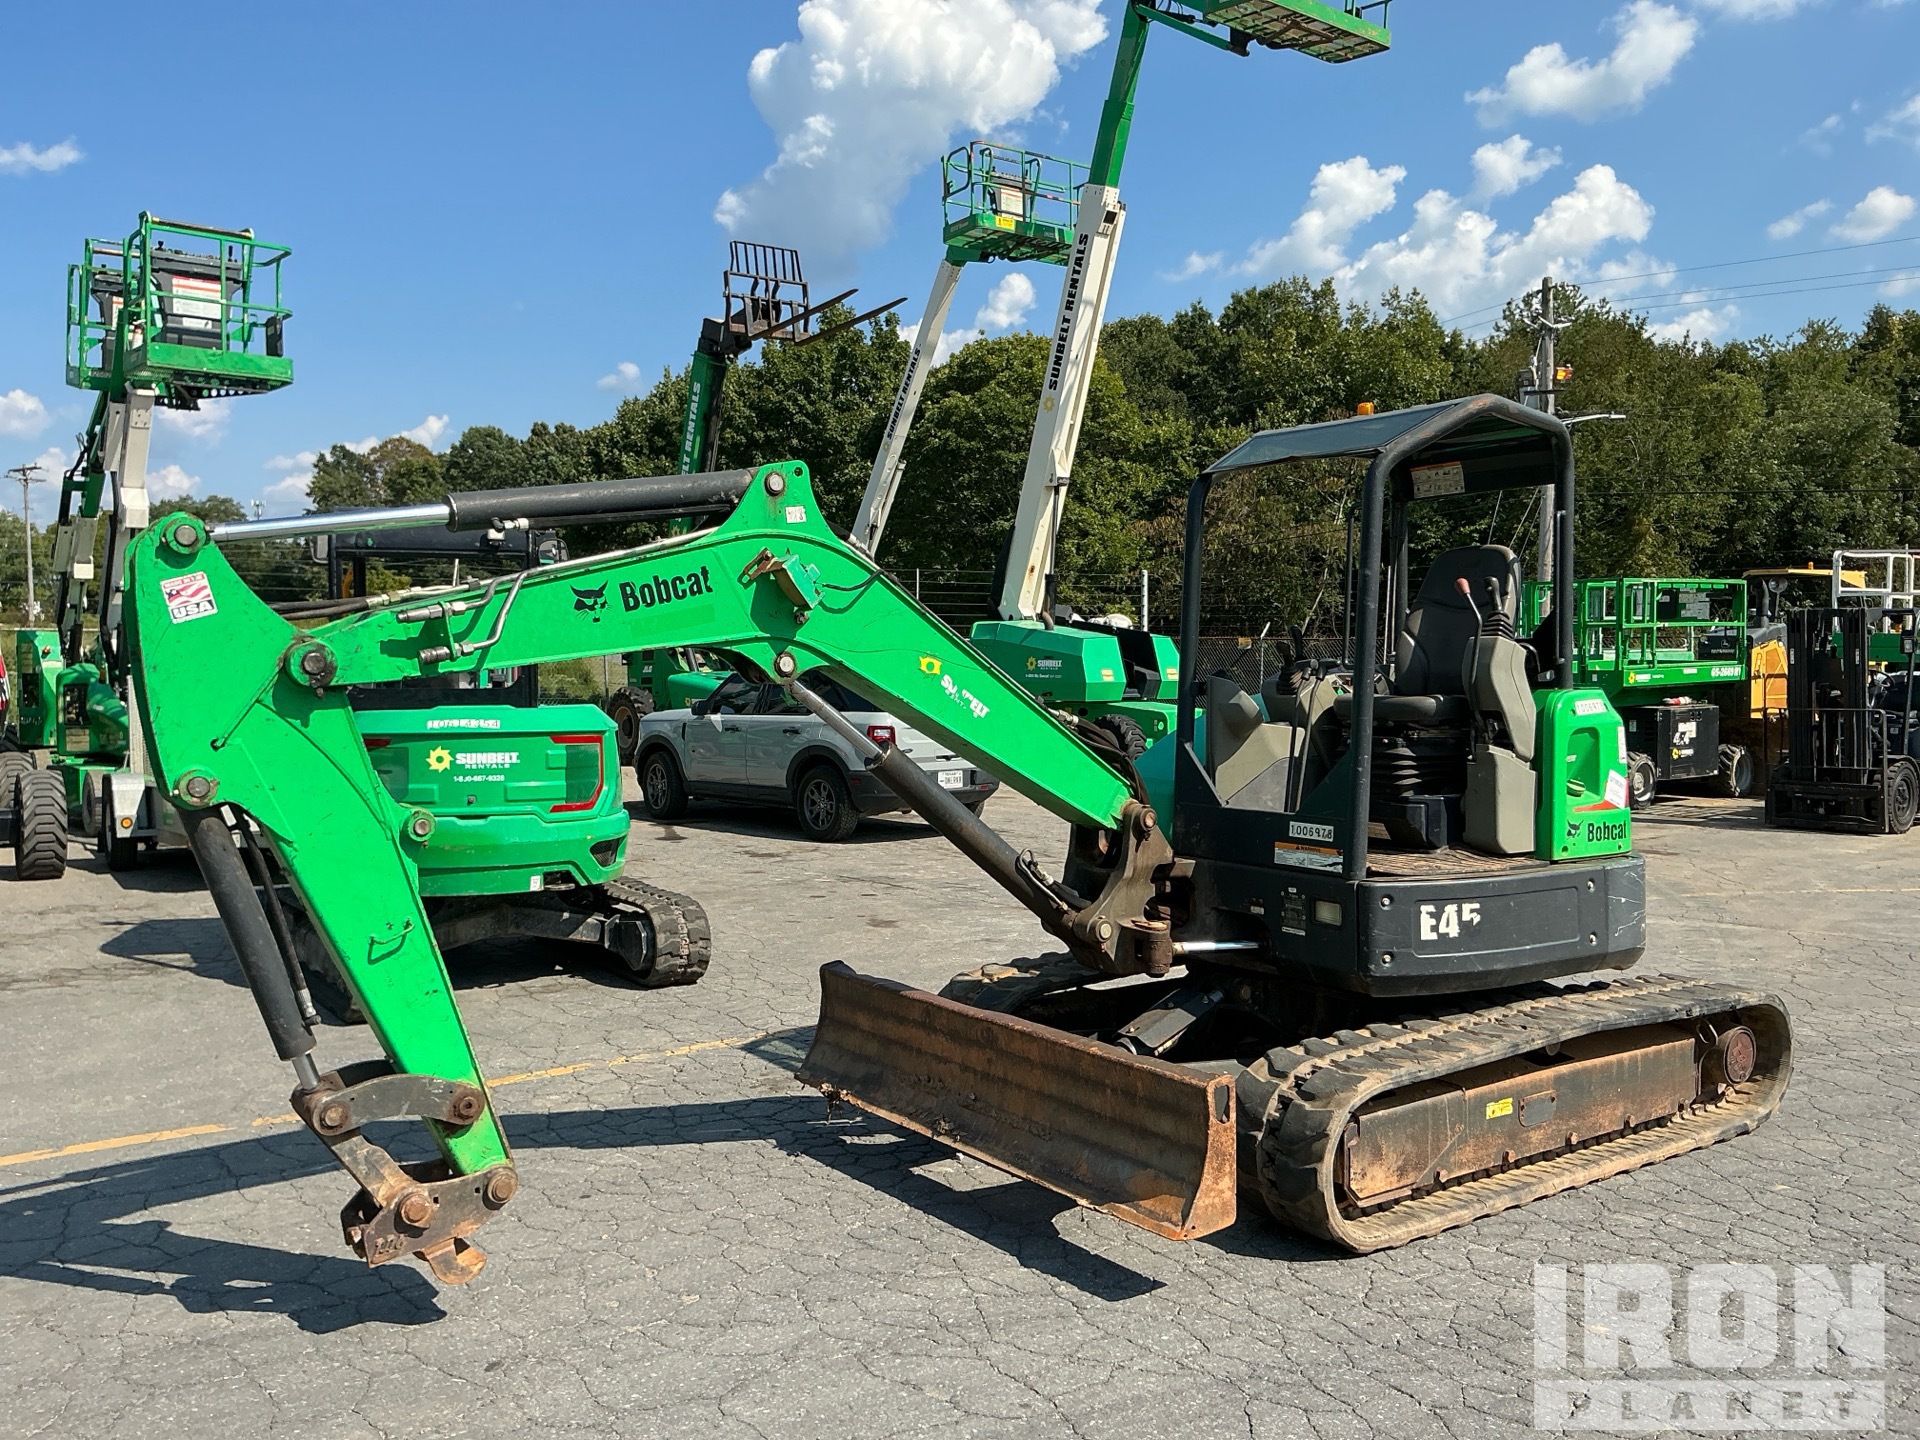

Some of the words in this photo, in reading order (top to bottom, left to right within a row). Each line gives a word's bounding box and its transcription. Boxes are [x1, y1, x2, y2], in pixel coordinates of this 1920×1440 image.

[1048, 315, 1072, 391] SUNBELT
[1064, 233, 1089, 311] RENTALS
[886, 394, 905, 441] SUNBELT
[901, 347, 922, 394] RENTALS
[684, 381, 701, 452] RENTALS
[618, 565, 714, 613] Bobcat
[171, 600, 214, 619] USA
[455, 752, 520, 765] SUNBELT
[1290, 824, 1334, 840] 1006978
[1586, 819, 1628, 843] Bobcat
[1419, 902, 1482, 941] E45
